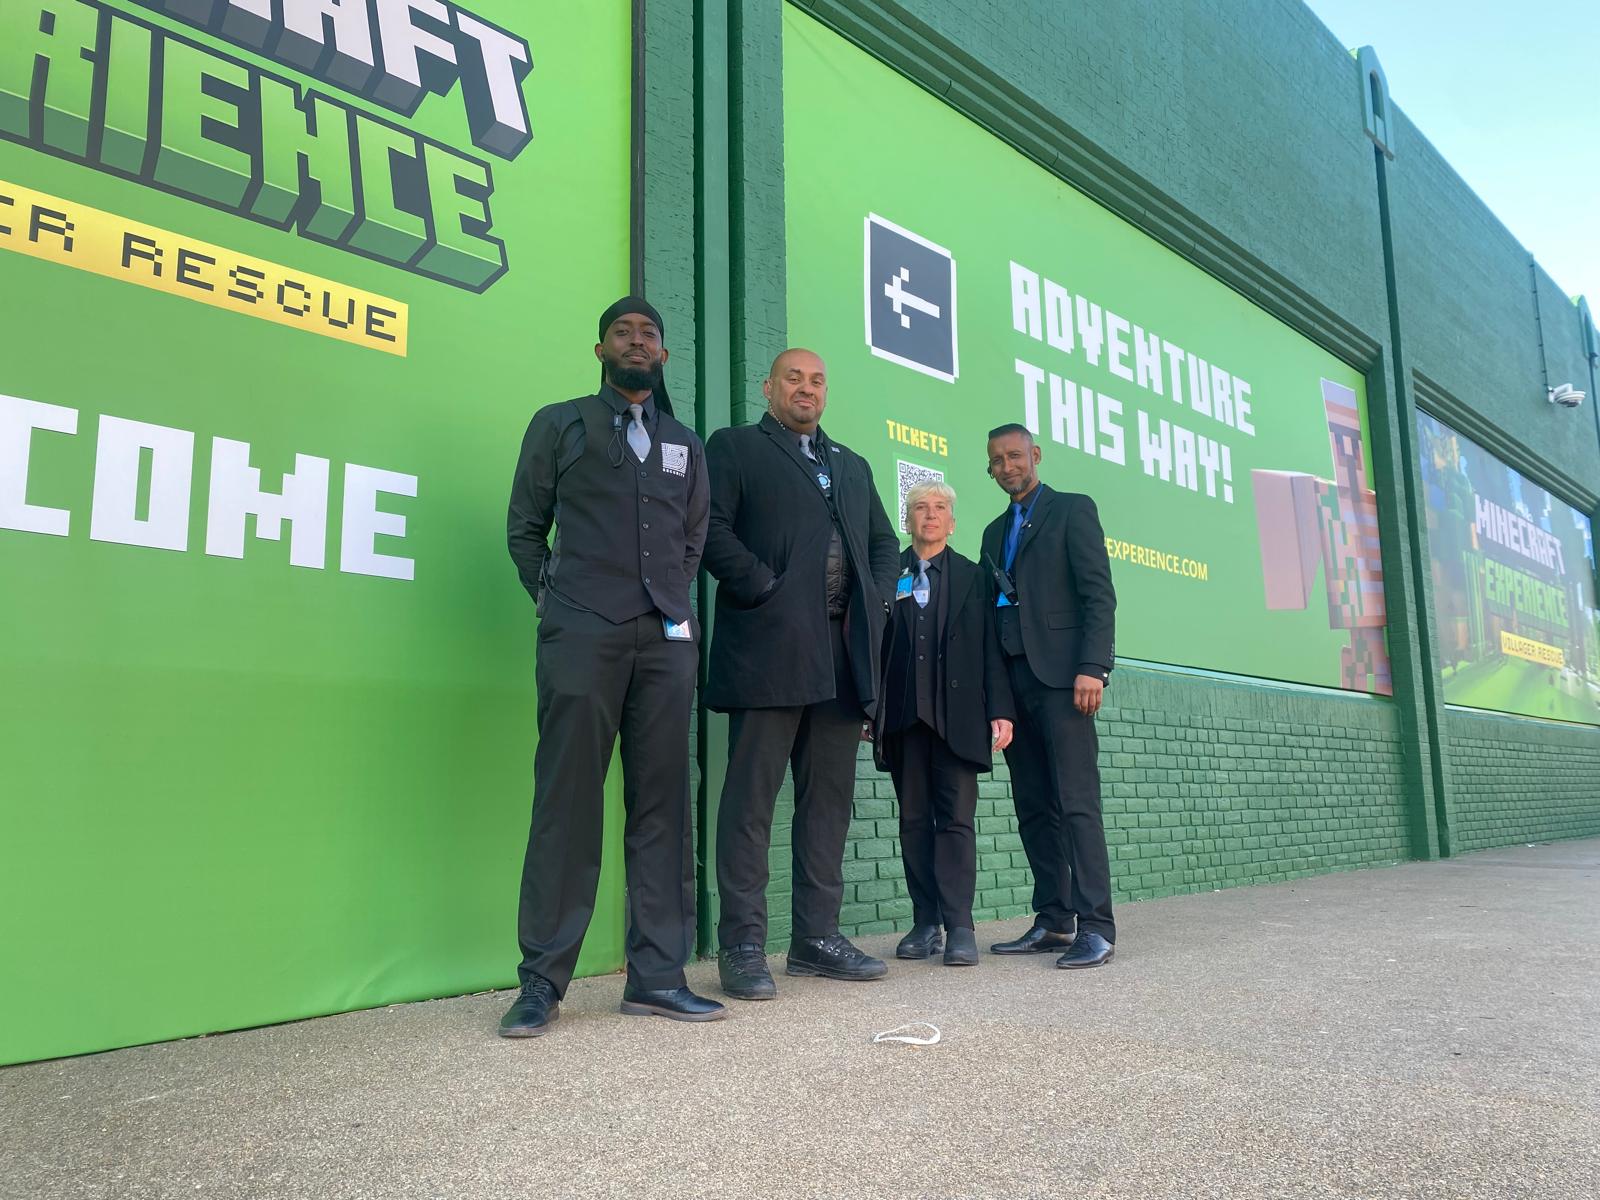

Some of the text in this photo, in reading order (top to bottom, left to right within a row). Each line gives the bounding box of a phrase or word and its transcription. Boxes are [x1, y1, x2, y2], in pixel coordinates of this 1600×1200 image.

[228, 0, 532, 158] AFT
[121, 231, 396, 342] RESCUE
[1009, 260, 1255, 436] ADVENTURE
[0, 394, 418, 581] COME
[886, 418, 948, 457] TICKETS
[1014, 358, 1234, 504] THIS WAY!
[1474, 493, 1566, 575] MINECRAFT
[1484, 557, 1569, 628] EXPERIENCE
